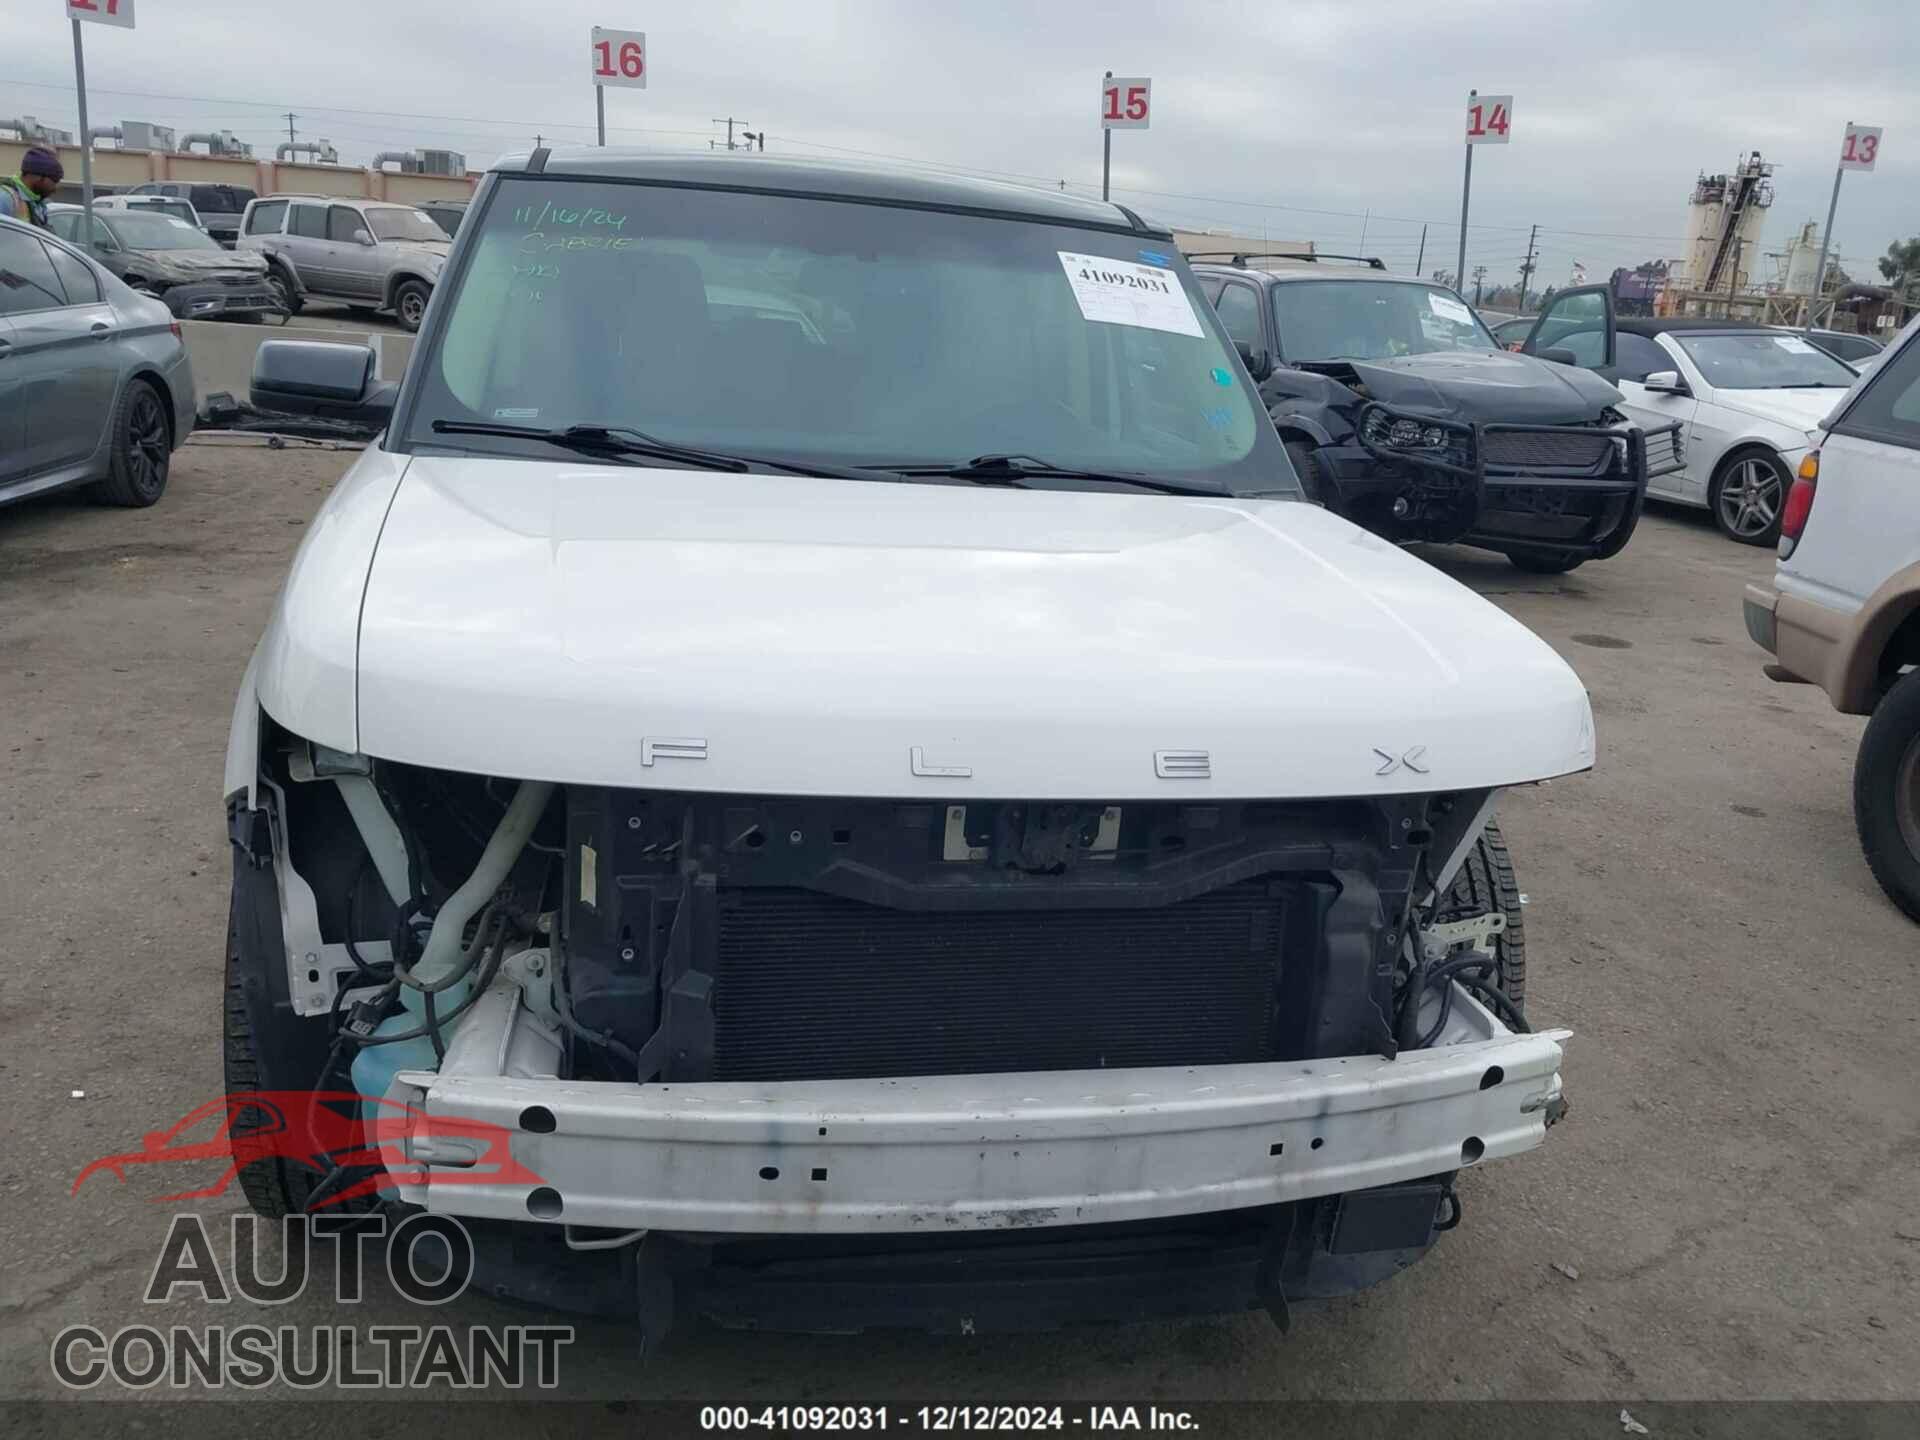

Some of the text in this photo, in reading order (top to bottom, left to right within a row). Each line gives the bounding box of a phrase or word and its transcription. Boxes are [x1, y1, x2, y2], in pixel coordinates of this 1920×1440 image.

[595, 41, 643, 78] 16
[1104, 87, 1148, 120] 15
[1468, 104, 1508, 136] 14
[1843, 134, 1877, 162] 13
[1078, 267, 1171, 295] 41092031
